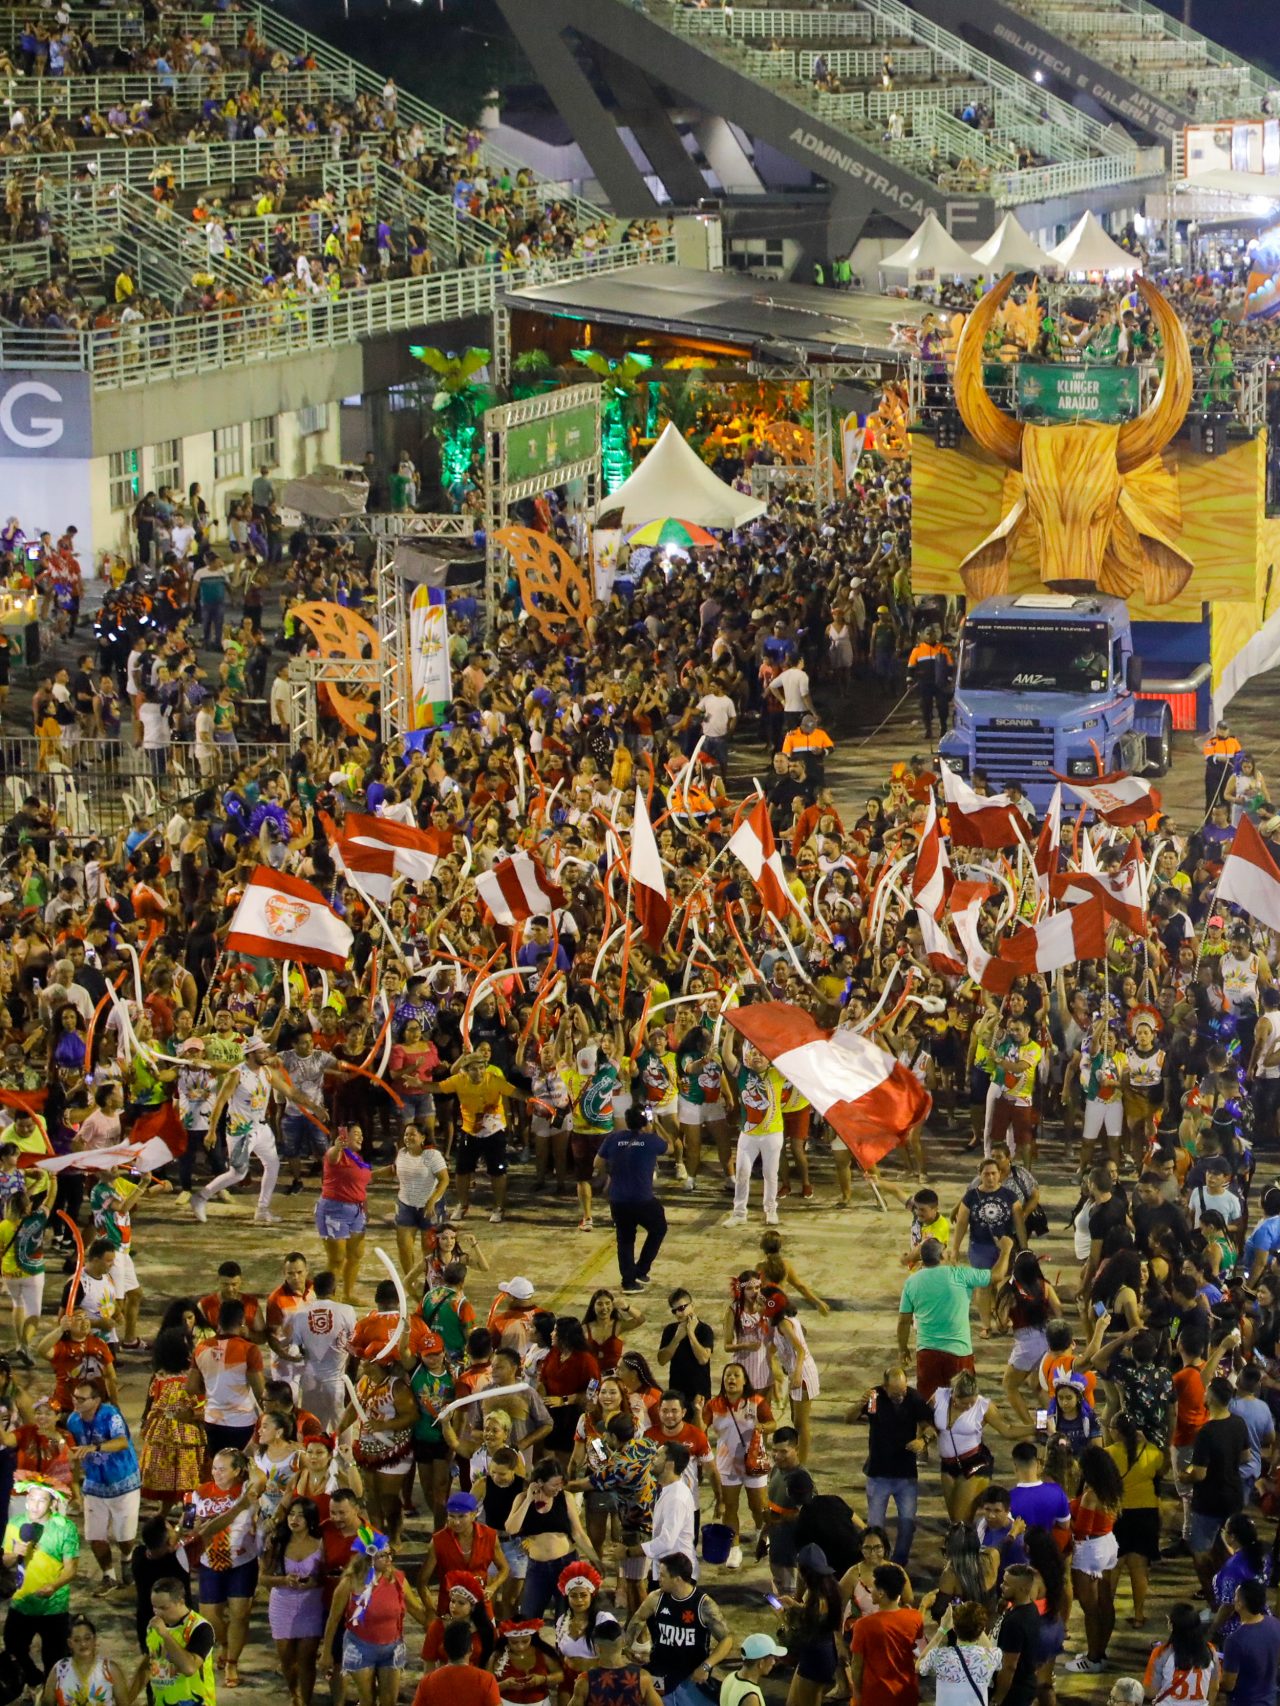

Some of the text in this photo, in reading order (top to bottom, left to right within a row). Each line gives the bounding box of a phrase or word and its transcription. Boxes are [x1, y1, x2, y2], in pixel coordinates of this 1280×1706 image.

[993, 23, 1071, 78] BIBLIOTECA
[1092, 84, 1149, 125] GALERIA
[1130, 91, 1177, 126] ARTES
[946, 202, 980, 236] F
[1056, 380, 1100, 394] KLINGER
[0, 381, 63, 448] G
[1012, 673, 1043, 685] AMZ
[996, 719, 1034, 727] SCANIA
[316, 1316, 326, 1328] G
[658, 1622, 697, 1648] CRVG
[1170, 1666, 1204, 1700] 81
